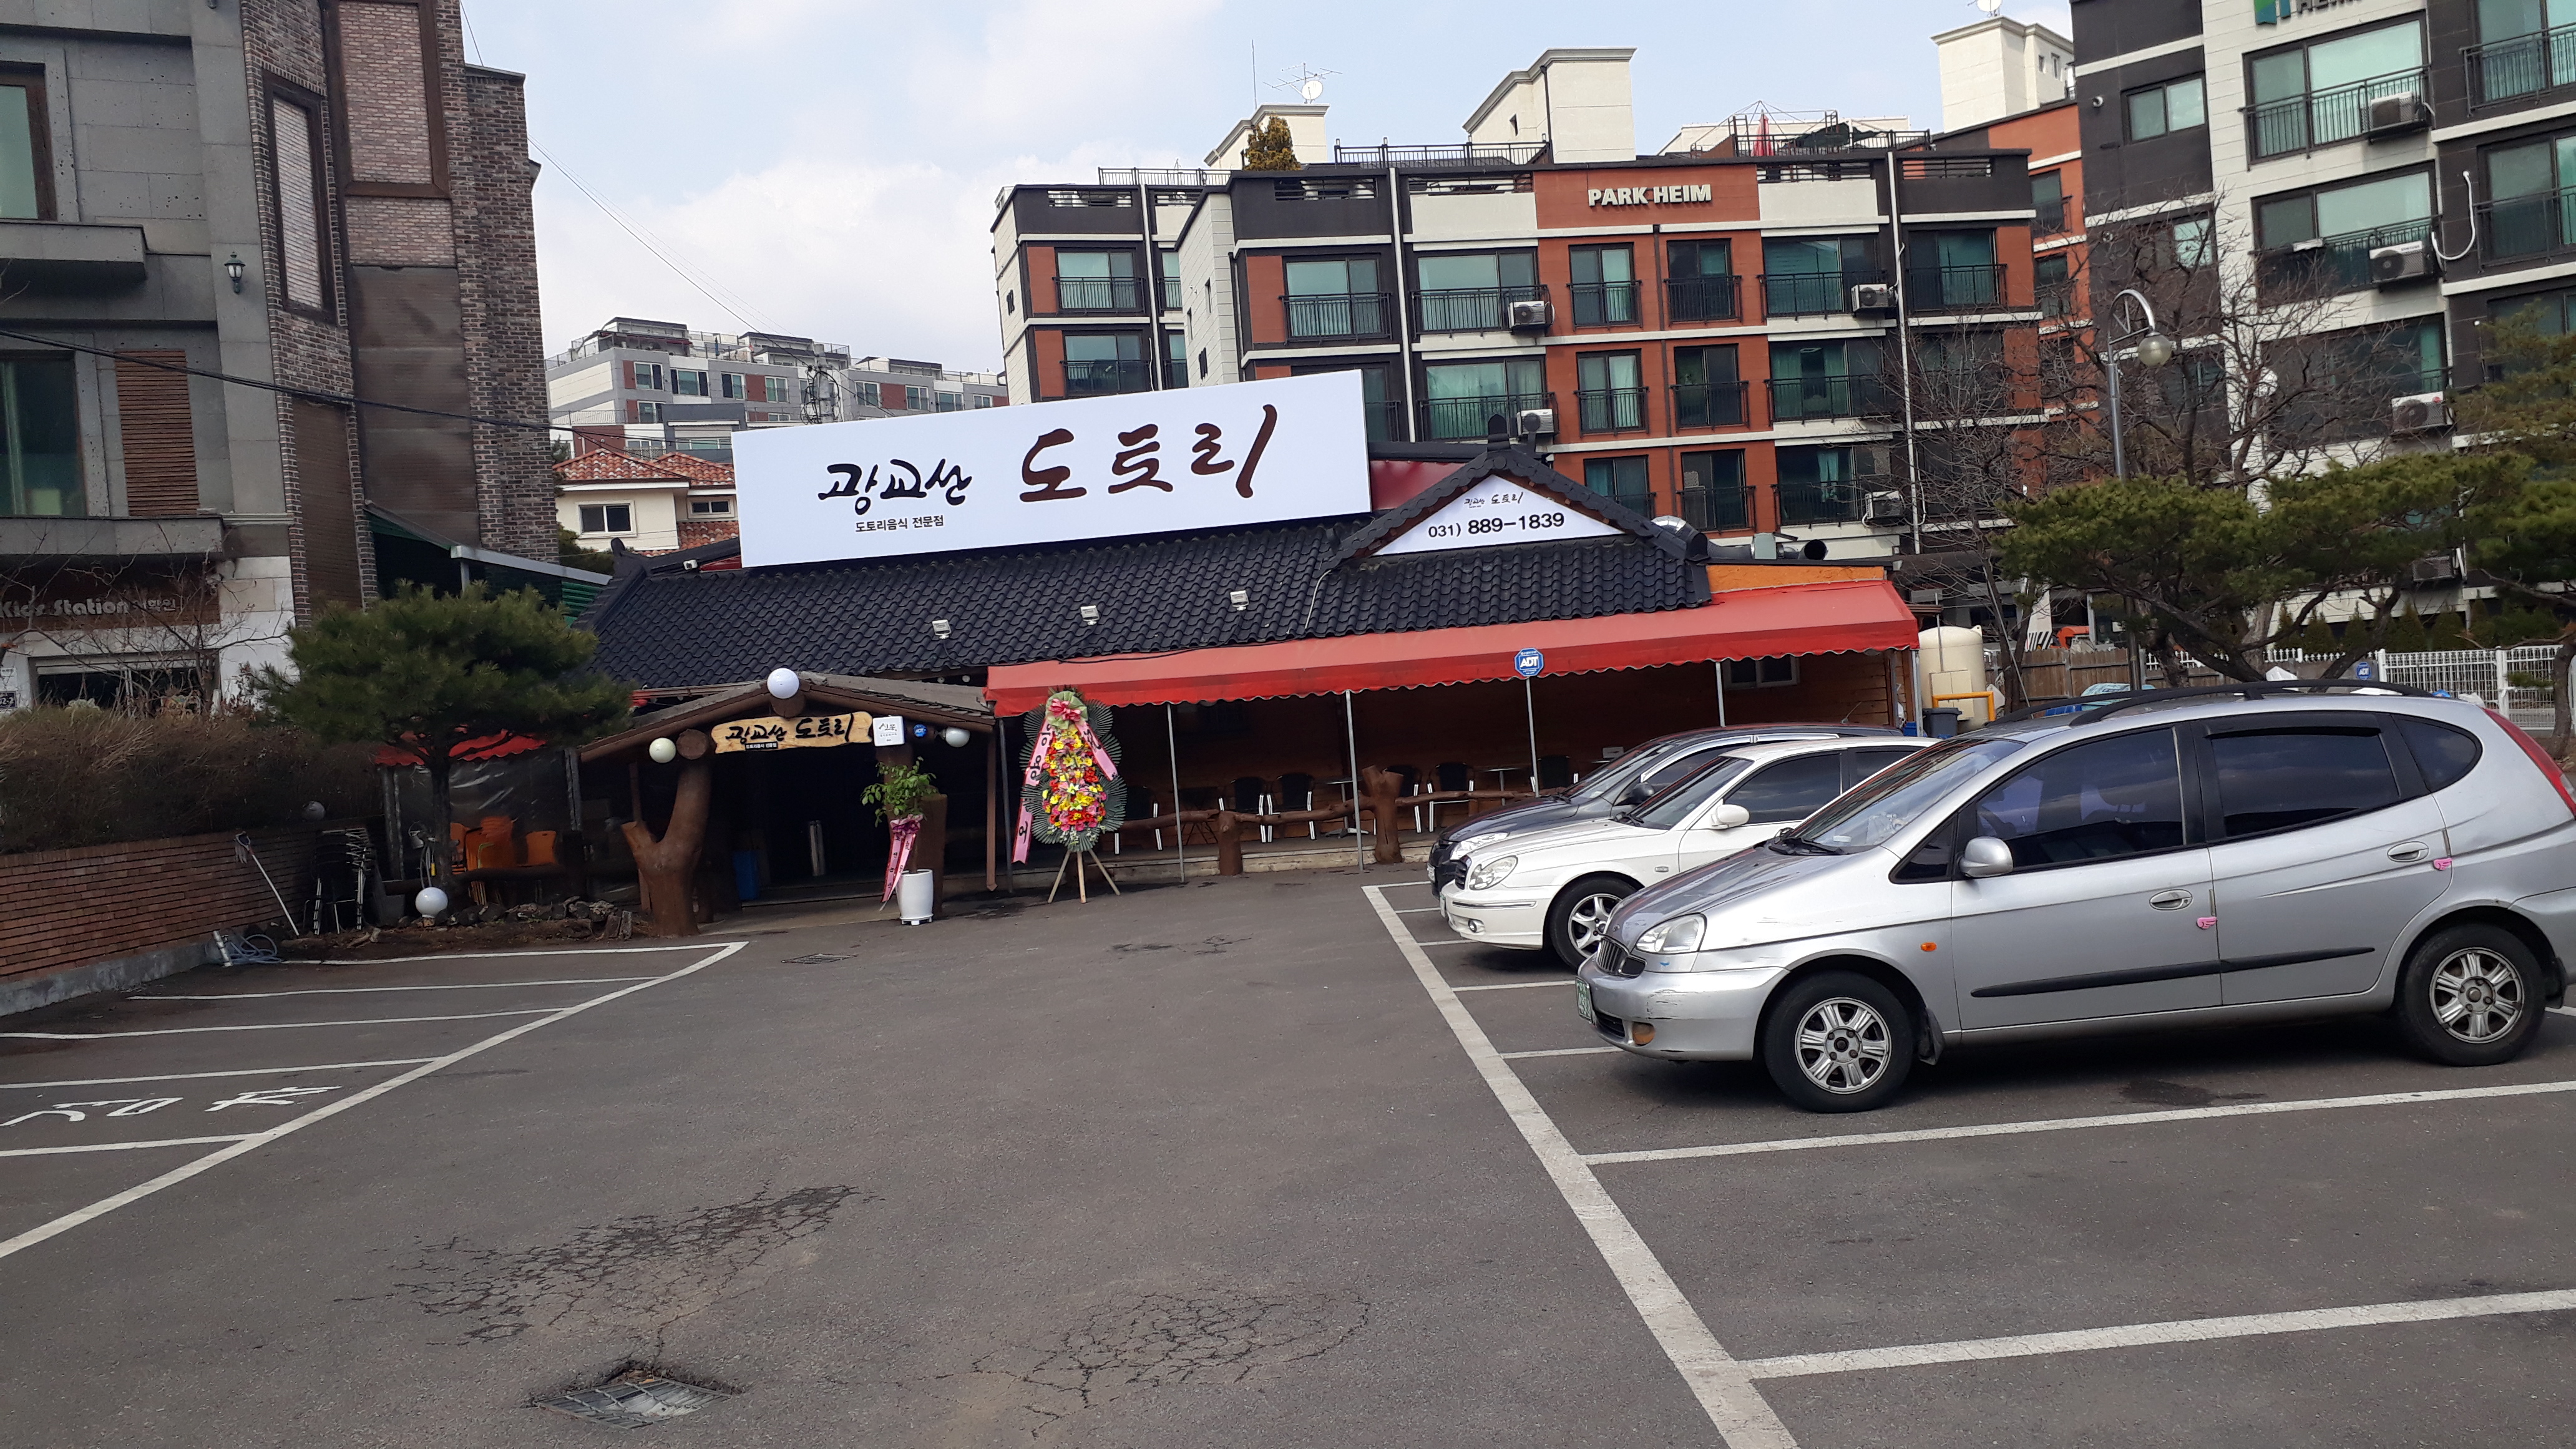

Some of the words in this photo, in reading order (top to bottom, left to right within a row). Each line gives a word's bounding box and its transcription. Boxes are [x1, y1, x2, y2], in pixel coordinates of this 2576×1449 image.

[1588, 187, 1649, 207] PARK
[1653, 184, 1712, 203] HEIM
[818, 458, 972, 515] 광교산
[1019, 403, 1278, 502] 도토리
[1491, 492, 1524, 504] 도토리
[855, 518, 908, 532] 도토리음식
[912, 515, 944, 529] 전문점
[1428, 522, 1461, 538] 031)
[1468, 512, 1564, 535] 889-1839
[53, 597, 129, 616] Station
[1520, 656, 1539, 668] ADT
[725, 724, 787, 744] 광교산
[795, 713, 854, 742] 도토리
